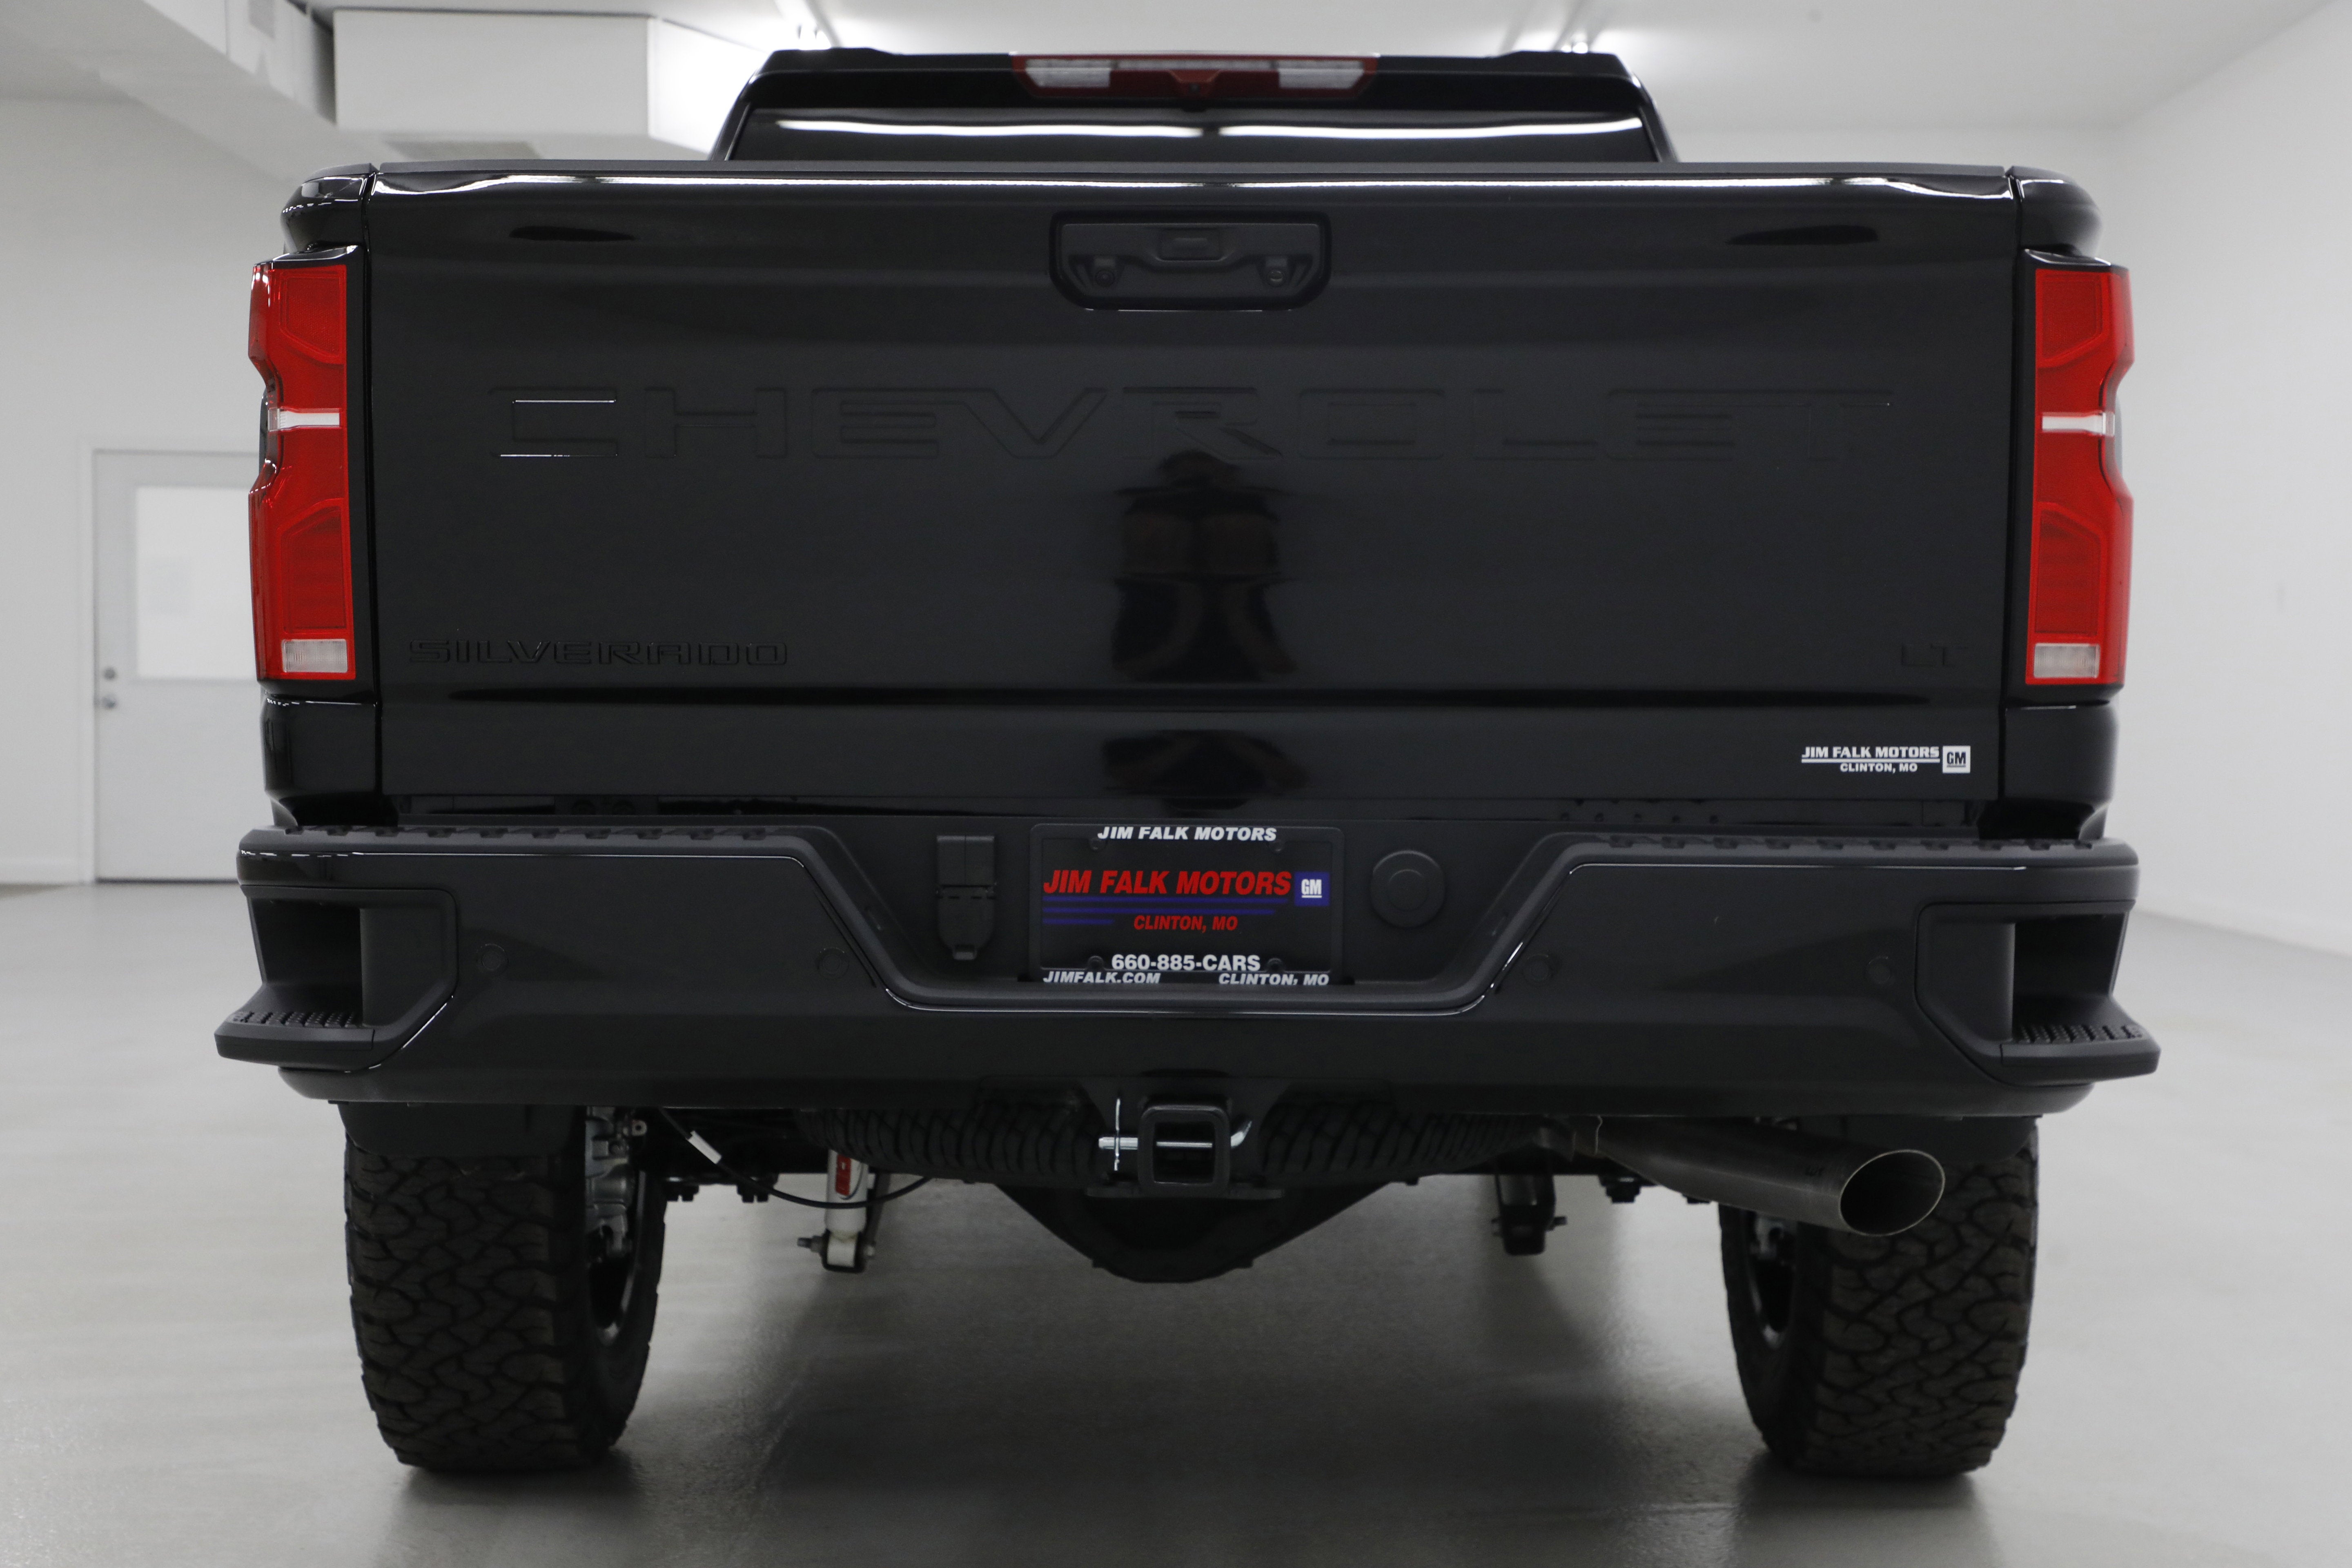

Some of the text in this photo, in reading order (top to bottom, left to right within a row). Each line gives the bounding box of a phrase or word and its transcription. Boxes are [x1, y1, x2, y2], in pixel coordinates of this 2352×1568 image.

[488, 386, 1895, 461] CHEVROLET
[408, 640, 788, 666] SILVERADO
[1802, 746, 1940, 758] JIM FALK MOTORS
[1947, 751, 1967, 765] GM
[1840, 763, 1918, 774] CLINTON, MO
[1097, 826, 1277, 842] JIM FALK MOTORS
[1043, 869, 1292, 895] JIM FALK MOTORS
[1301, 878, 1322, 895] GM
[1134, 915, 1238, 933] CLINTON, MO
[1111, 954, 1261, 971] 660-885-CARS
[1043, 971, 1161, 984] JIMFALK.COM
[1218, 972, 1330, 986] CLINTON, MO
